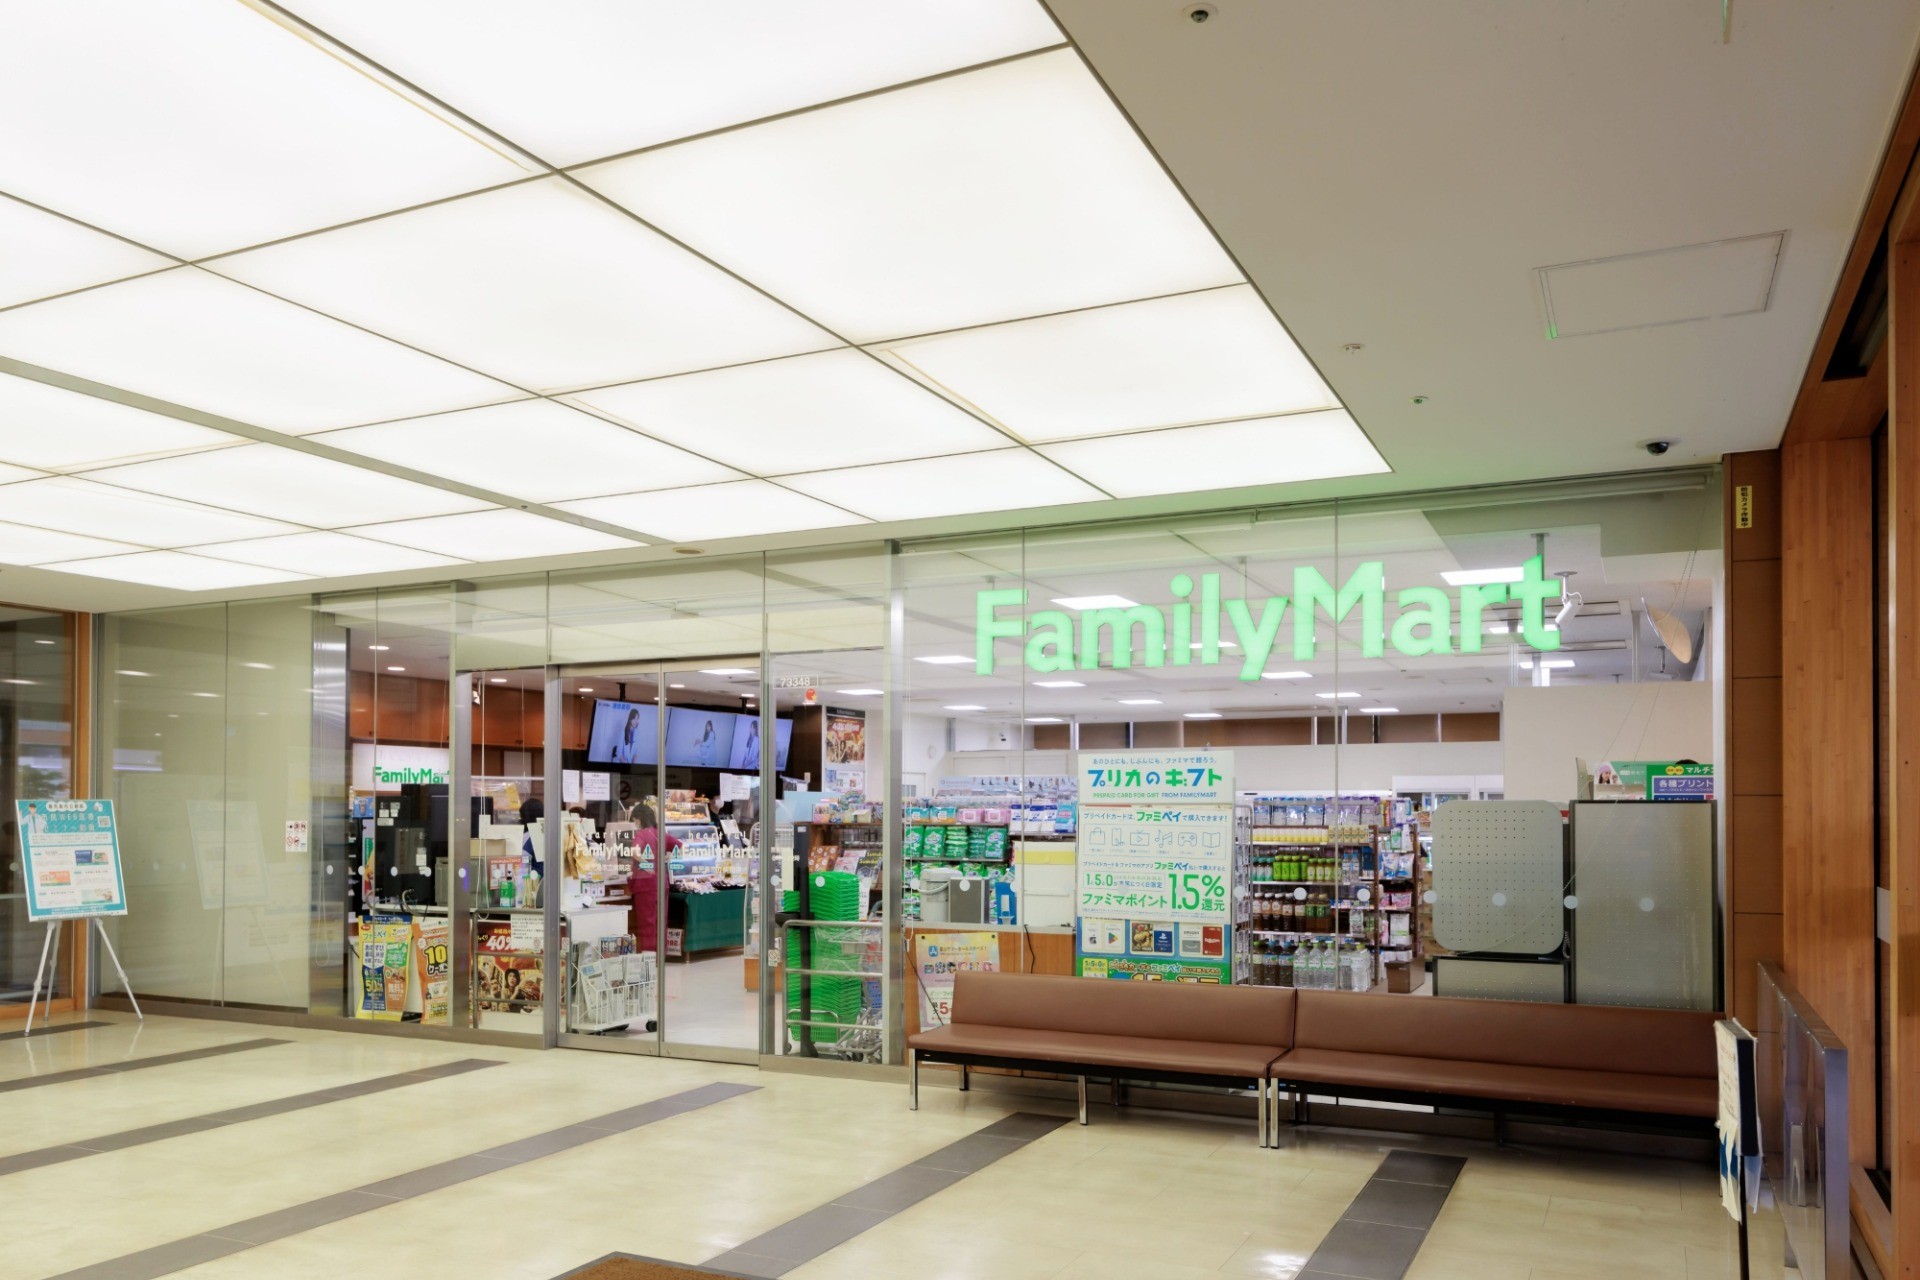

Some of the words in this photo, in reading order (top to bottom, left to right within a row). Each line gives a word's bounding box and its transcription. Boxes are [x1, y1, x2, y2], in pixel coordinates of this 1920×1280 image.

[976, 554, 1561, 681] FamilyMart
[1087, 768, 1222, 787] プリカのギフト
[1180, 791, 1217, 799] FAMILYMART
[575, 842, 641, 860] FamilyMart
[683, 843, 753, 860] FamilyMart
[1082, 892, 1167, 909] ファミマポイント
[1201, 899, 1225, 911] 還元
